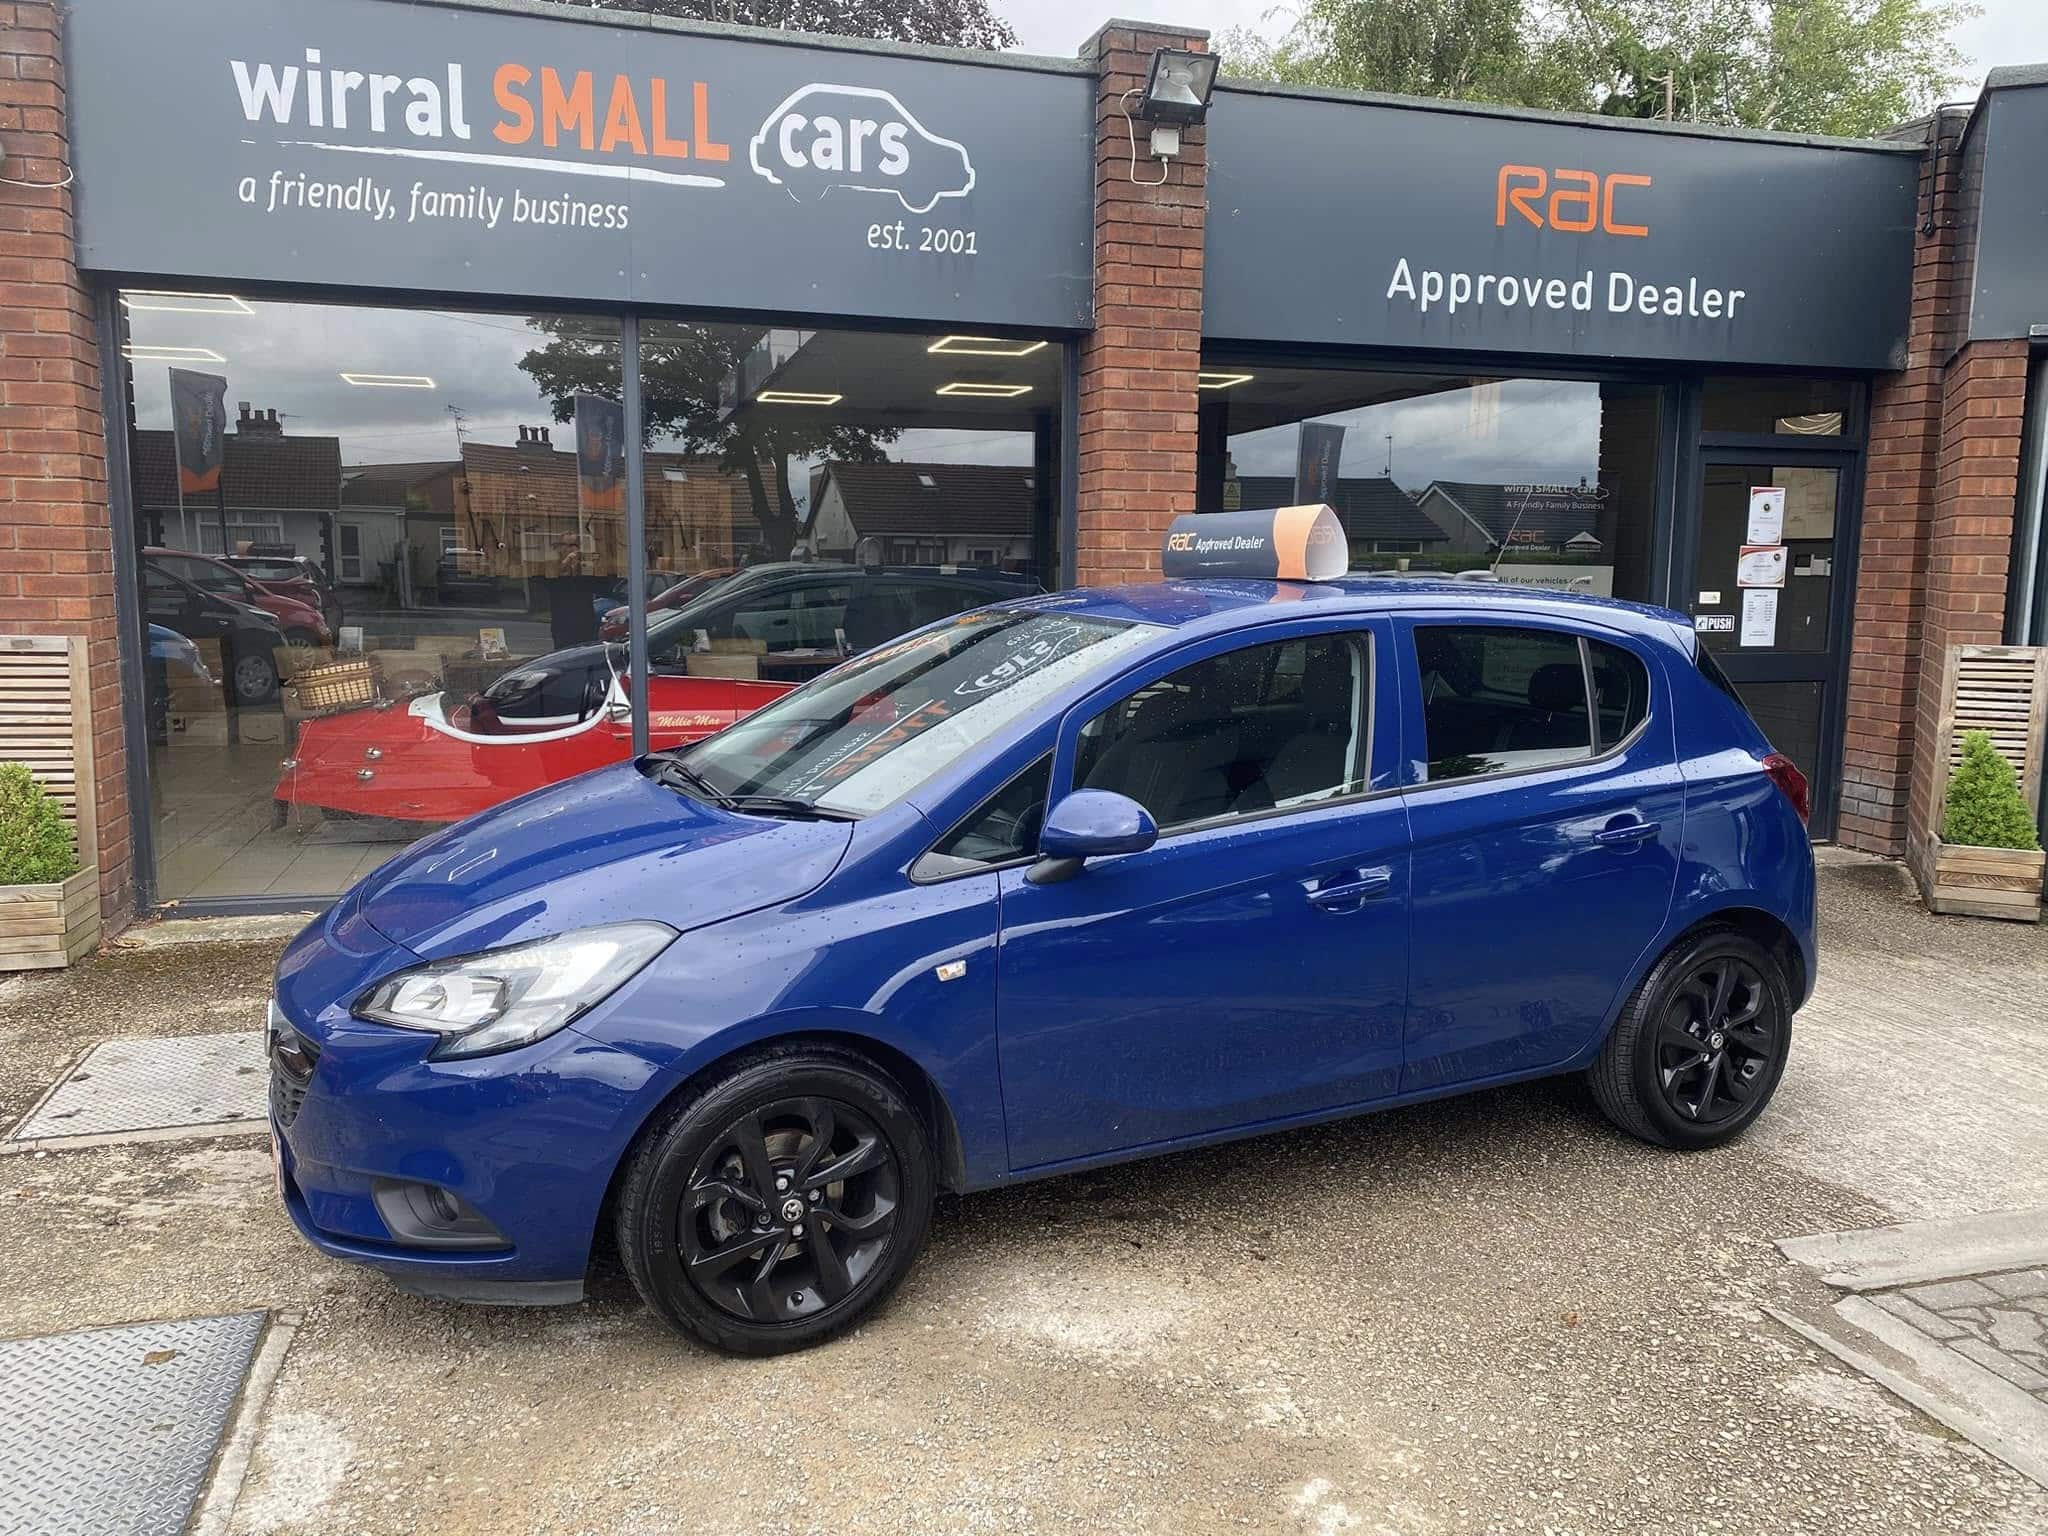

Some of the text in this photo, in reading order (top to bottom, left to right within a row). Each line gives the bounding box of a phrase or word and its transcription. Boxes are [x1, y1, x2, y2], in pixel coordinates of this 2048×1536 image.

[229, 47, 910, 176] wirral SMALL cars
[238, 169, 629, 230] a friendly, family business
[1496, 164, 1652, 237] RAC
[867, 220, 978, 255] est. 2001
[1386, 257, 1746, 319] Approved Dealer
[1535, 485, 1569, 493] SMALL
[1167, 532, 1264, 554] RAC Approved Dealer
[1708, 618, 1732, 630] PUSH
